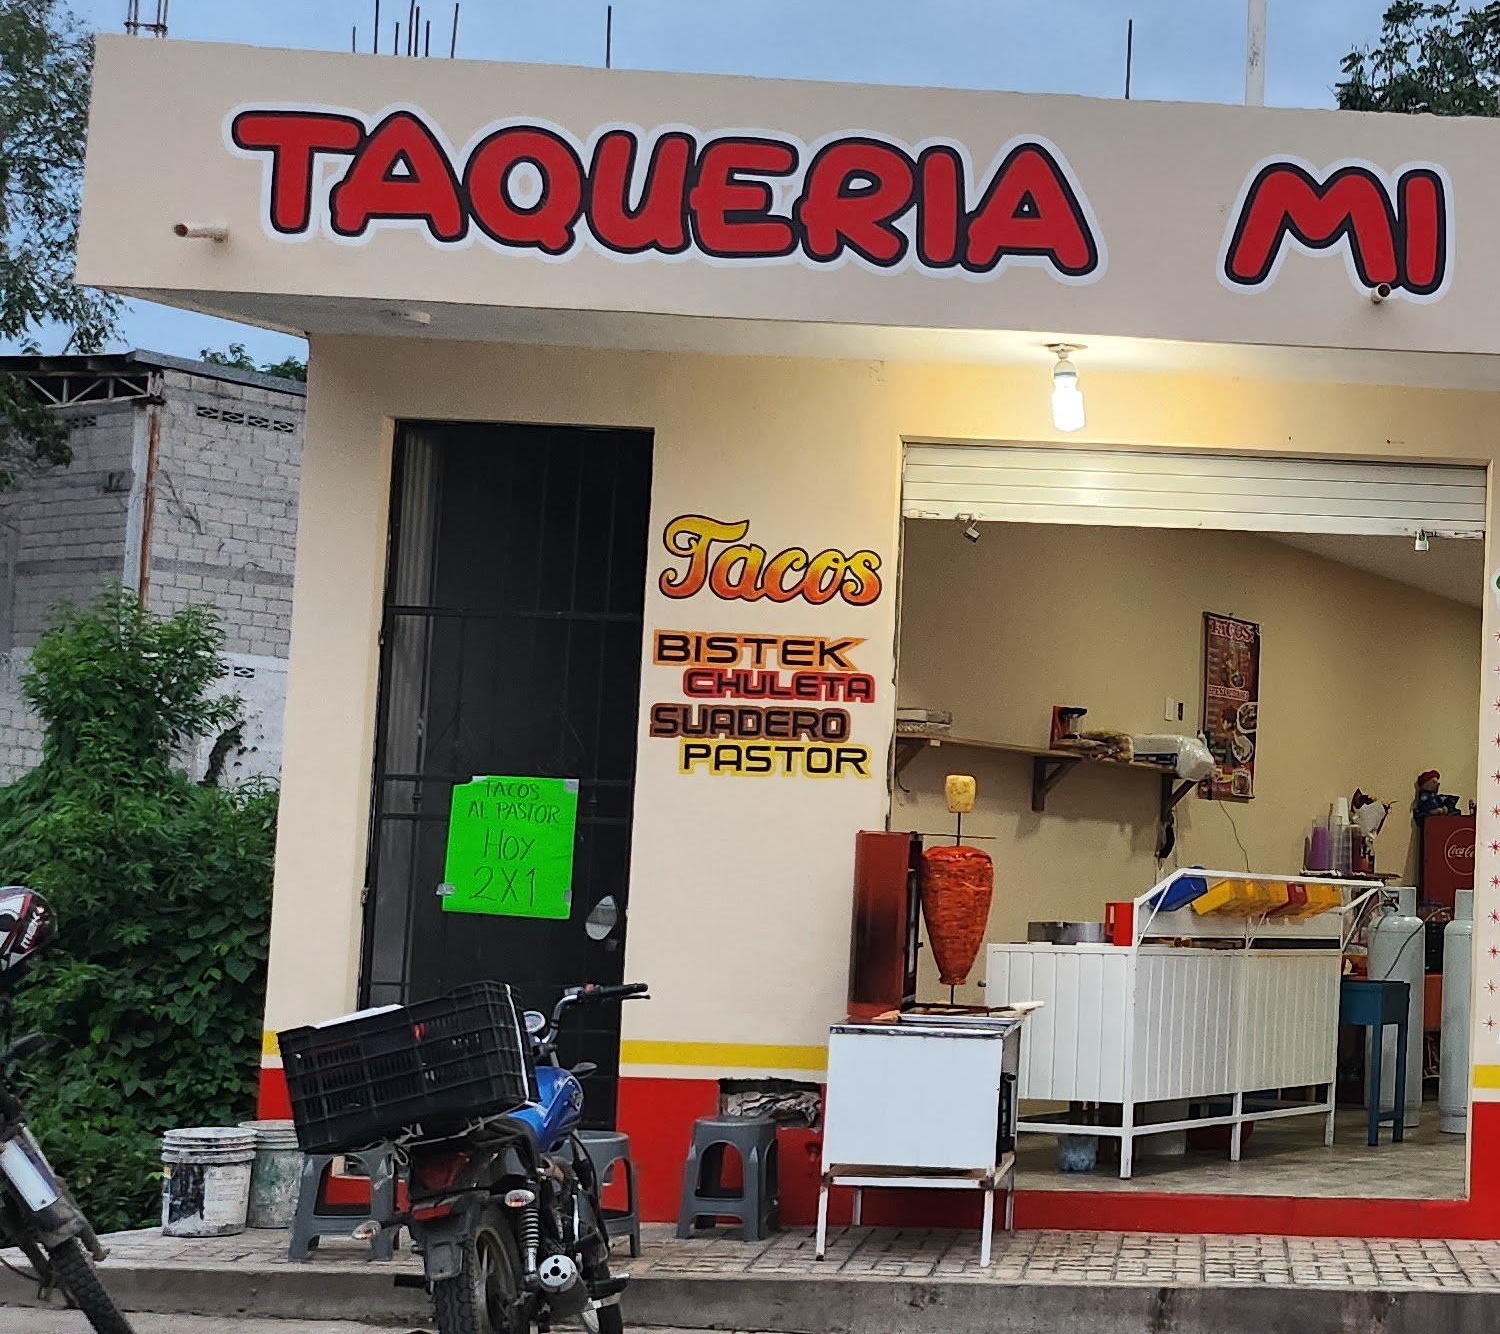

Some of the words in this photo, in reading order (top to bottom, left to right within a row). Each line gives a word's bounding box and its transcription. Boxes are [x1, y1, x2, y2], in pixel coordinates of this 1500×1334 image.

[229, 107, 1101, 279] TAQUERIA
[1223, 161, 1448, 296] MI
[658, 514, 882, 606] Tacos
[654, 630, 865, 671] BISTEK
[683, 668, 875, 702] CHULETA
[650, 703, 850, 742] SUADERO
[682, 740, 871, 777] PASTOR
[485, 780, 540, 801] TACOS
[496, 801, 561, 824] PASTOR
[483, 827, 535, 860] HOY
